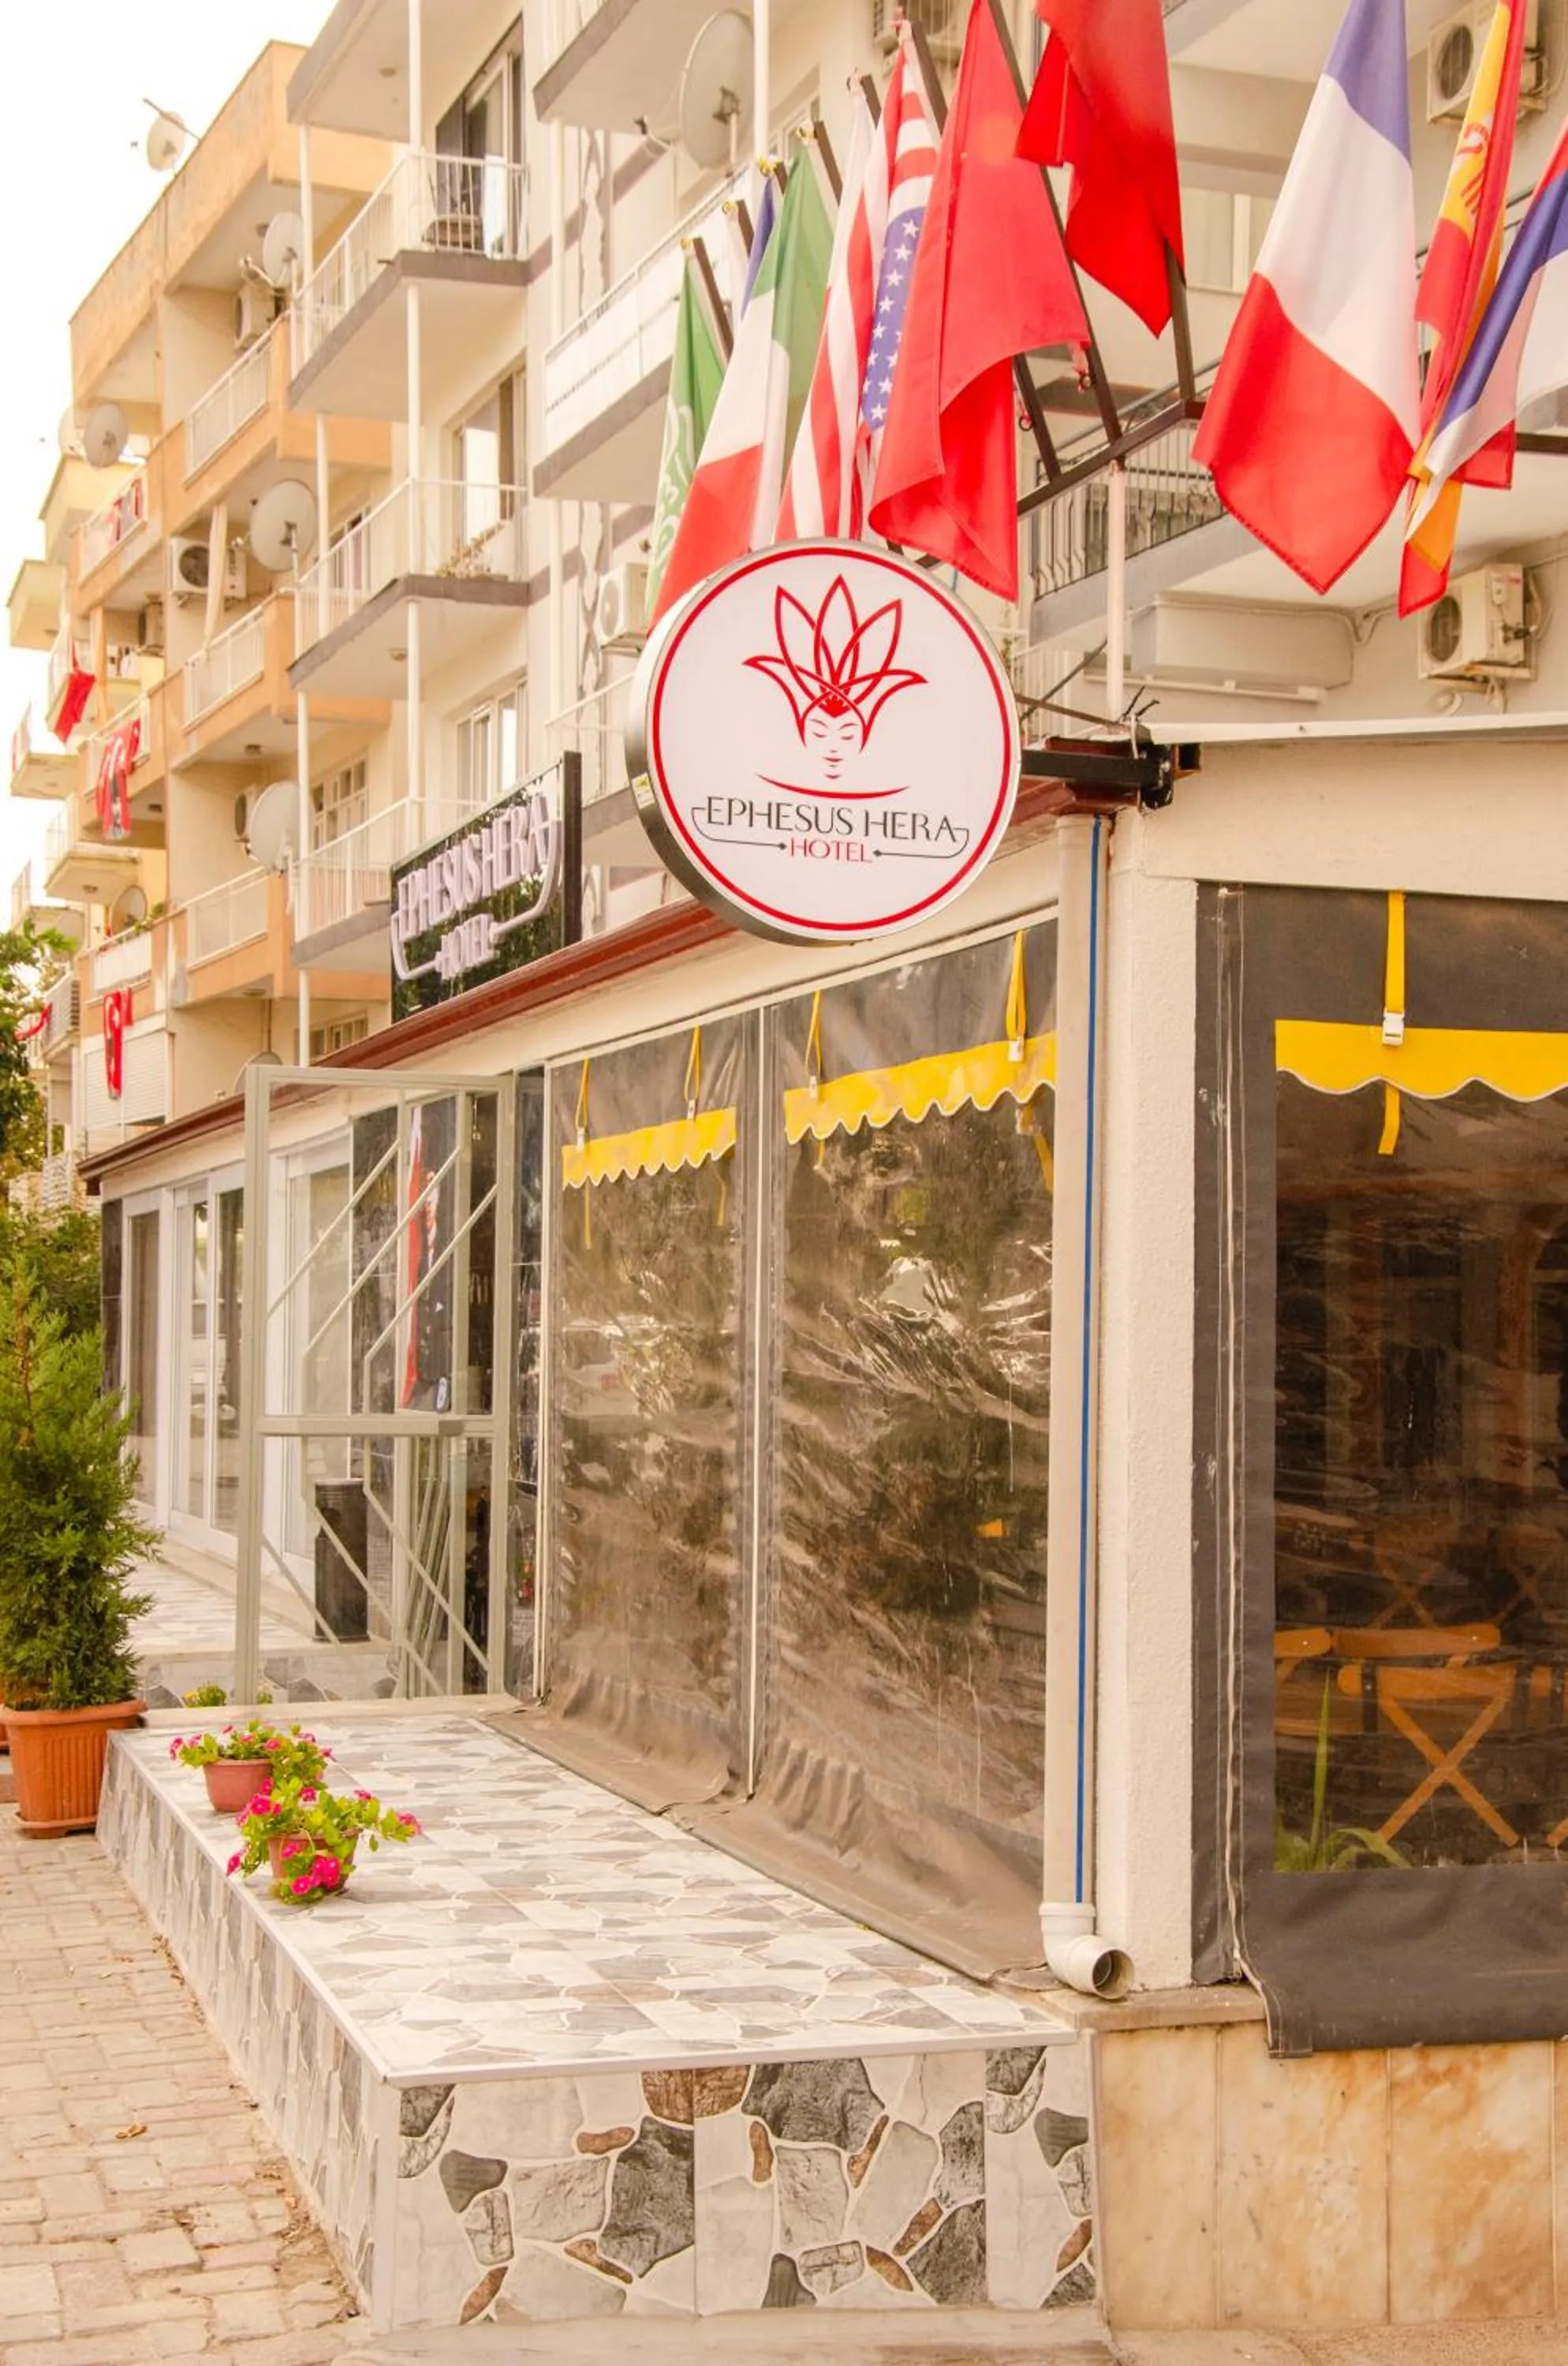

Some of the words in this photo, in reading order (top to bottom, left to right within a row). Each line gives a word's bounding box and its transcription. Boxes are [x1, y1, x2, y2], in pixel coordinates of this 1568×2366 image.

[480, 792, 551, 898] HERA
[707, 795, 853, 836] EPHESUS
[864, 808, 958, 844] HERA
[790, 837, 874, 864] HOTEL
[439, 913, 499, 980] HOTEL
